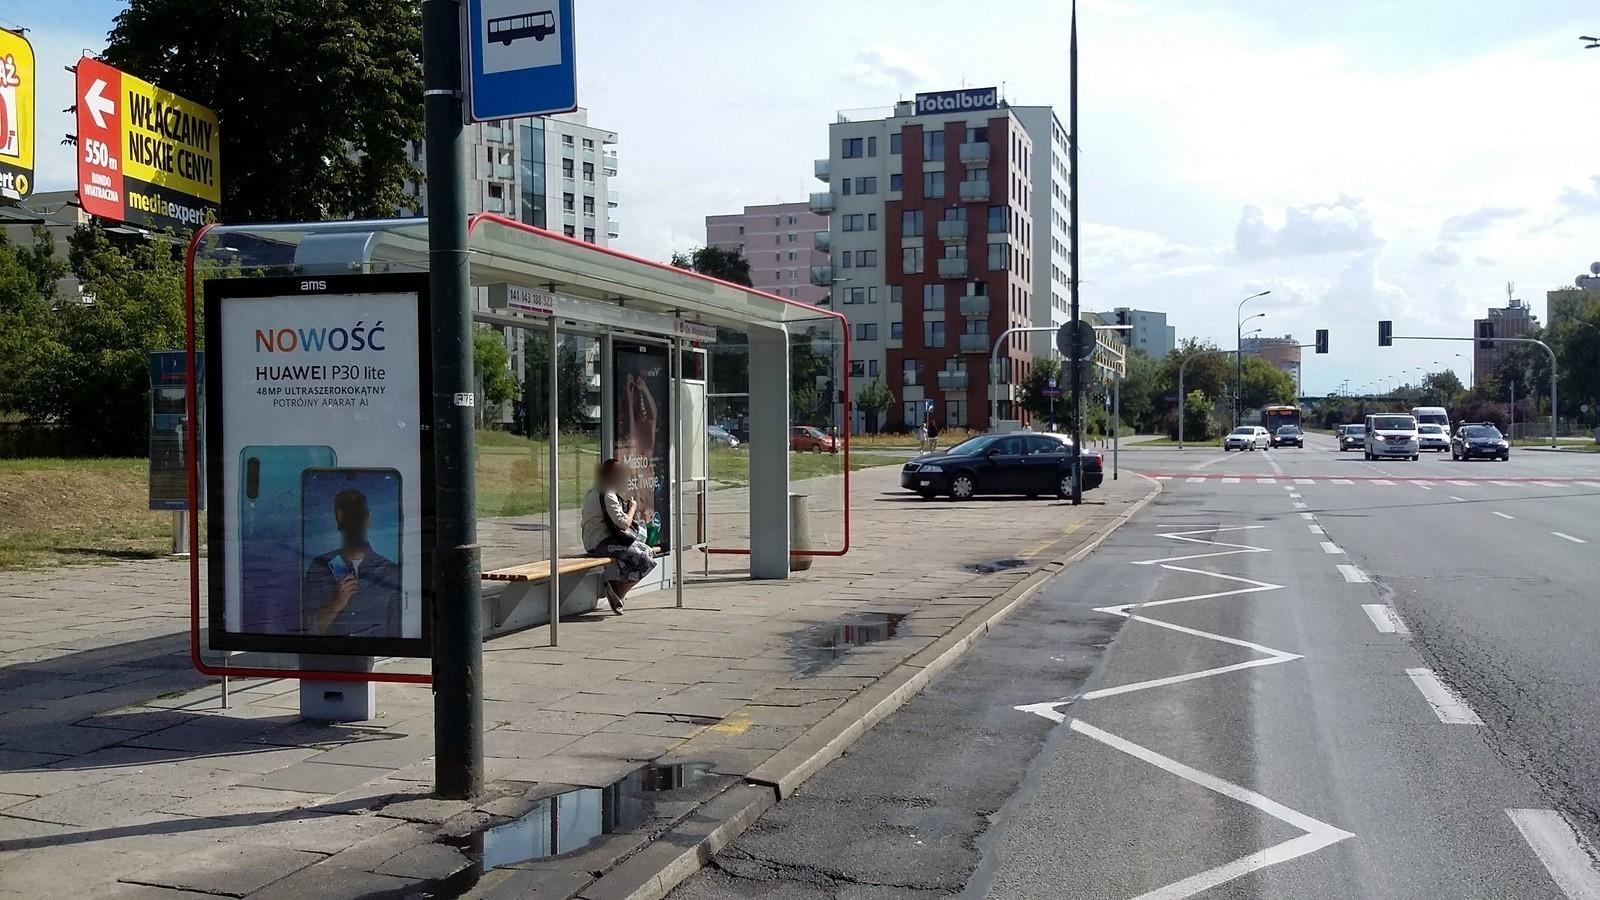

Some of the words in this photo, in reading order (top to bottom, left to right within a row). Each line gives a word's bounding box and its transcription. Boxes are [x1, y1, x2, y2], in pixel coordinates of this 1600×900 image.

[917, 89, 995, 111] Totalbud
[129, 91, 212, 152] WŁĄCZAMY
[129, 130, 173, 173] NISKIE
[177, 149, 213, 187] CENY!
[91, 171, 111, 188] RONDO
[84, 183, 119, 203] WIATRACZNA
[129, 191, 205, 226] mediaexpert
[300, 280, 327, 290] ams
[255, 320, 386, 352] NOWOŚĆ
[256, 365, 326, 380] HUAWEI
[332, 365, 360, 380] P30
[364, 366, 386, 380] lite
[284, 386, 386, 396] ULTRASZEROKOKĄTNY
[273, 396, 319, 407] POTRÓJNY
[321, 398, 356, 407] APARAT
[359, 398, 369, 407] AI
[623, 453, 649, 468] Miasto
